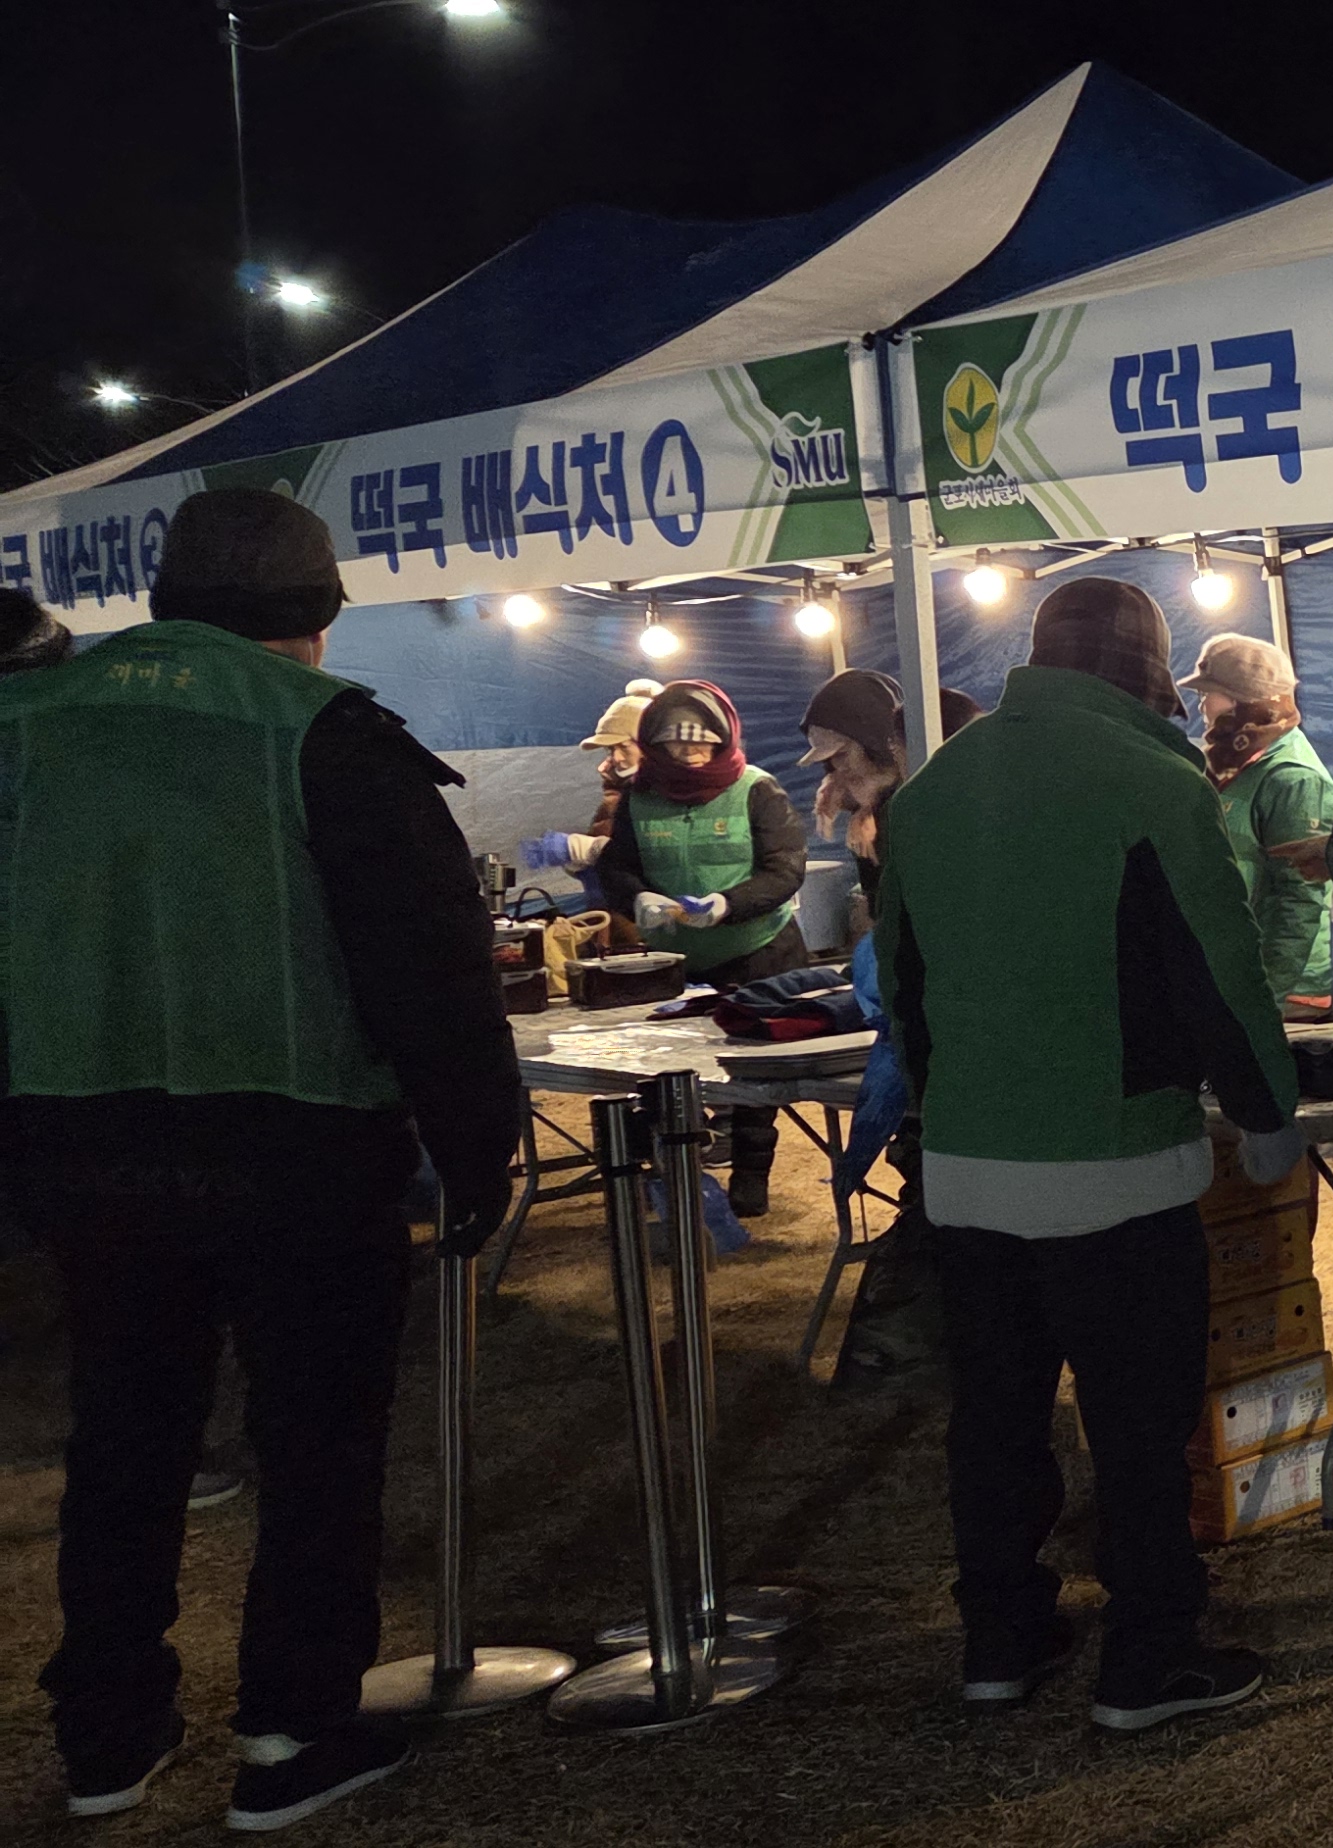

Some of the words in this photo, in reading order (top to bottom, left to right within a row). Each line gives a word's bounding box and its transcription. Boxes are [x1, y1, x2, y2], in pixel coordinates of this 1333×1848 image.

[772, 431, 846, 488] SMU
[1110, 329, 1302, 493] 떡국
[39, 514, 137, 610] 배식처
[351, 461, 447, 574] 떡국
[461, 430, 634, 560] 배식처
